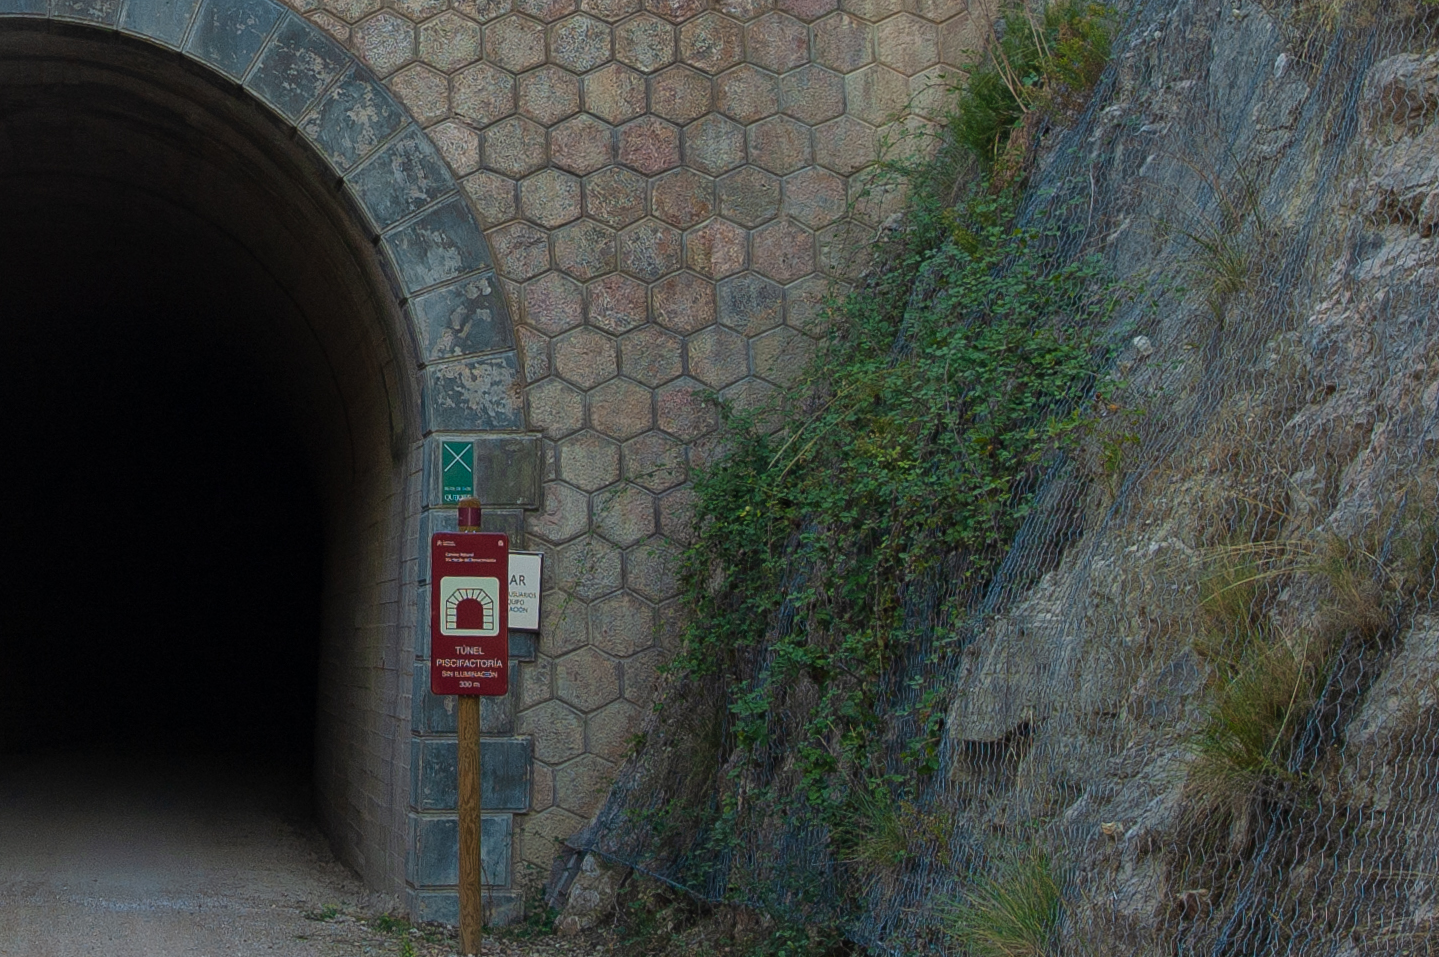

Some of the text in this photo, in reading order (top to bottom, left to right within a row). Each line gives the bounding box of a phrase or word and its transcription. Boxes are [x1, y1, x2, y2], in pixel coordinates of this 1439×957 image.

[455, 645, 485, 655] TÚNEL
[436, 658, 503, 668] PISCIFACTORÍA
[442, 669, 498, 678] SIN ILUMINACIÓN
